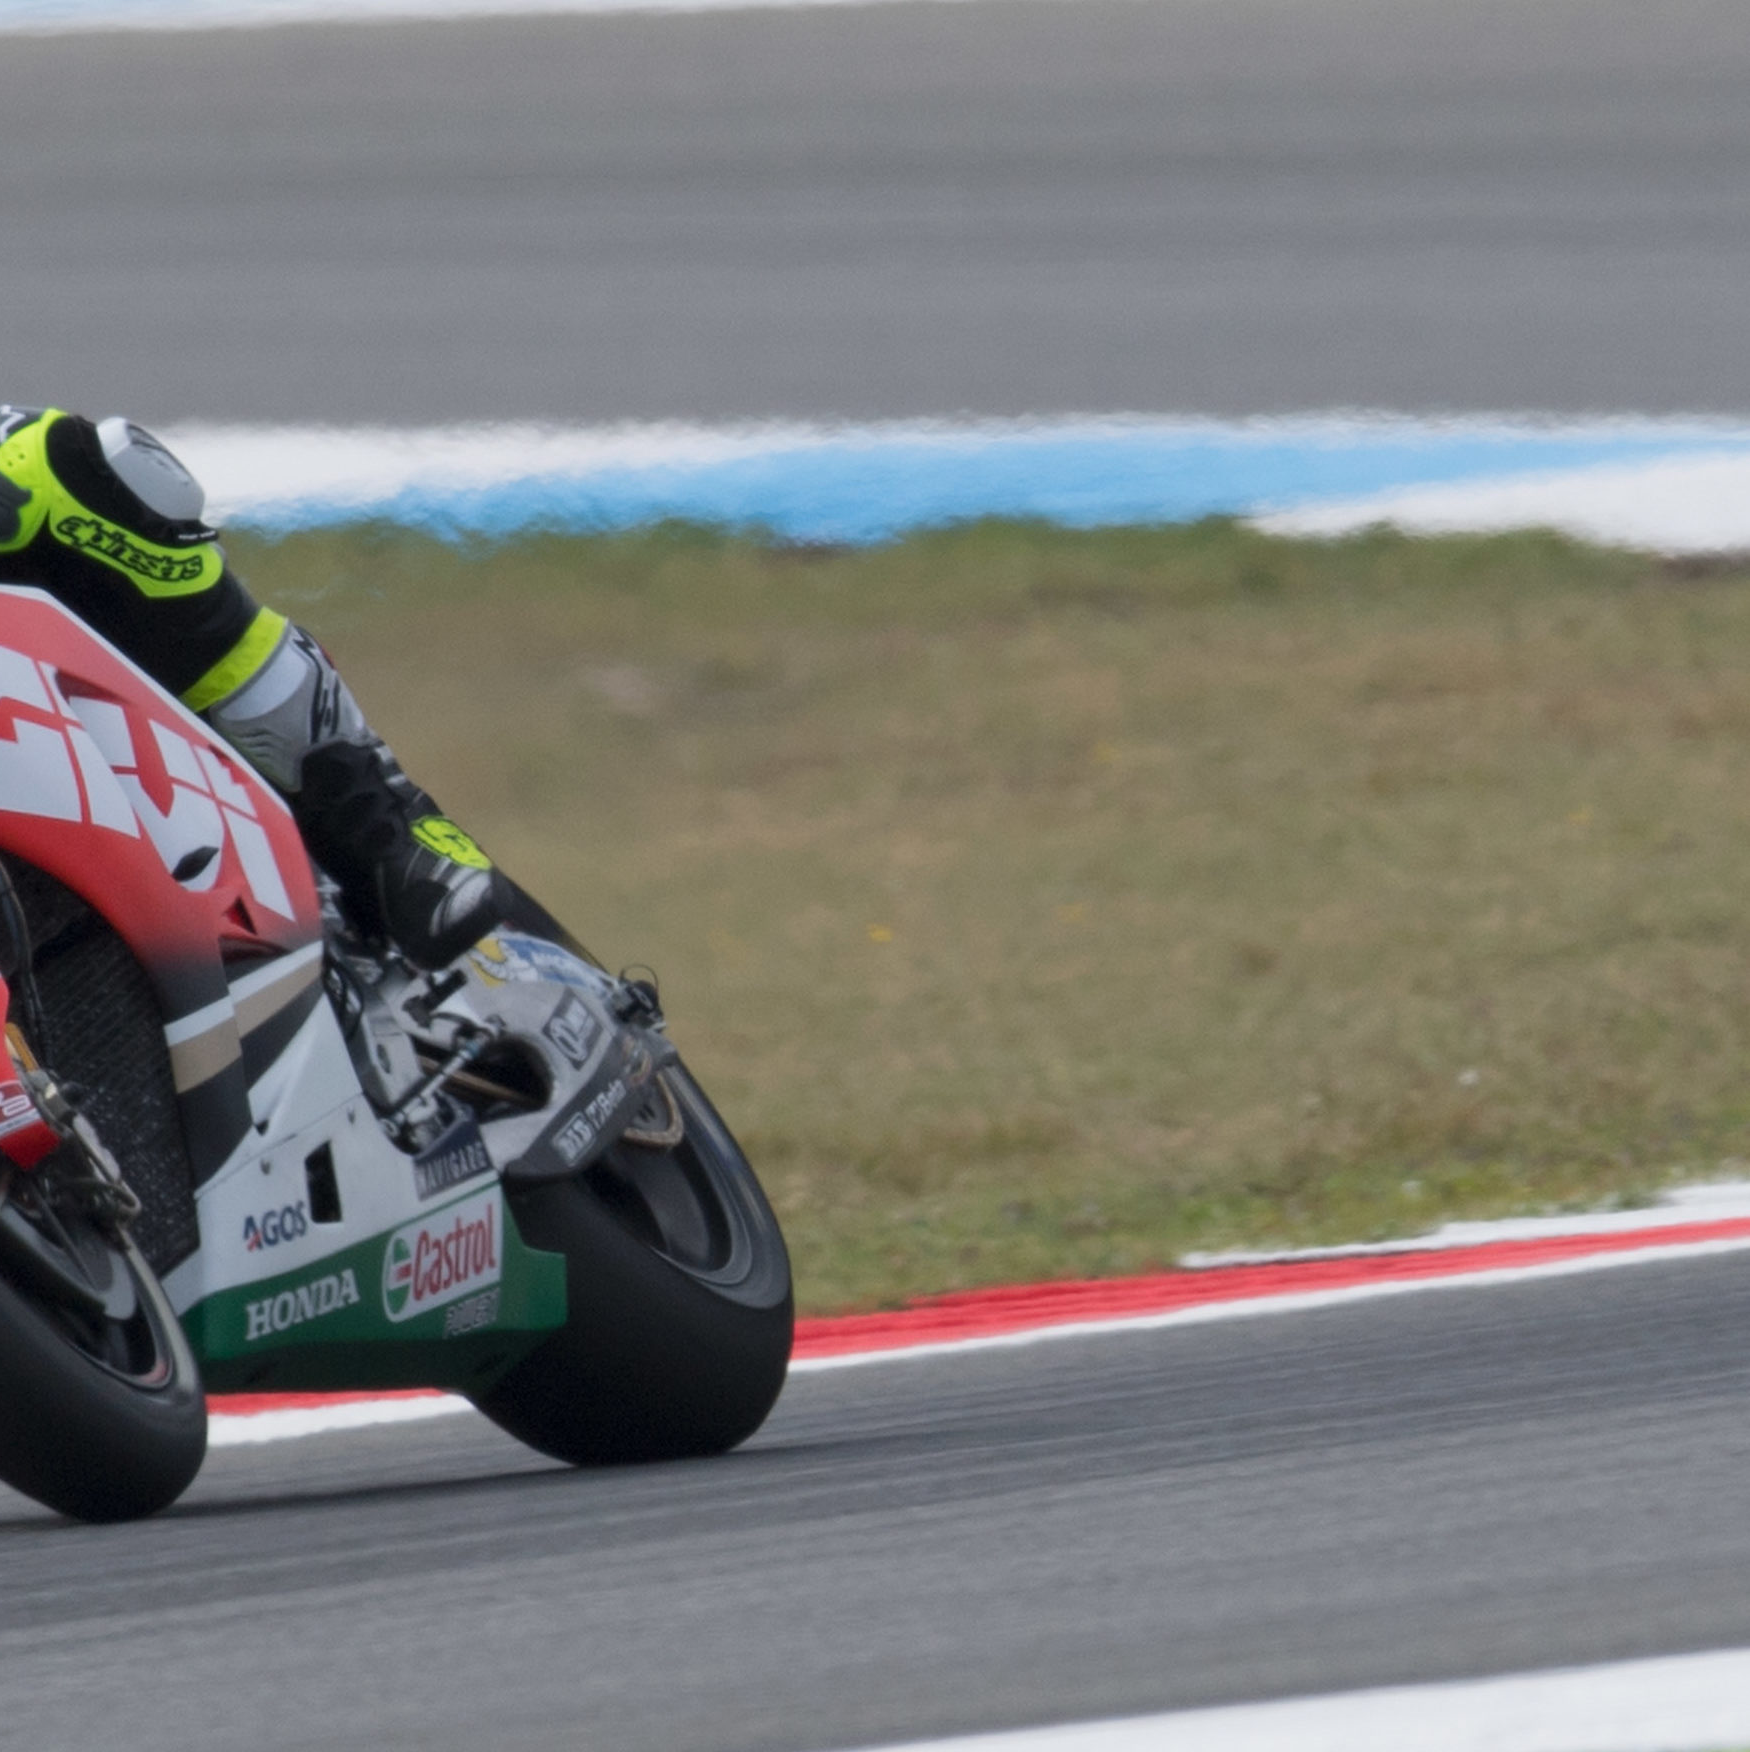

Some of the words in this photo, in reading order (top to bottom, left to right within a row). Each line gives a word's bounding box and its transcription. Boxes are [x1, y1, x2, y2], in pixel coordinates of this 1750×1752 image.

[243, 1200, 308, 1252] AGOS
[413, 1201, 496, 1301] Castrol
[245, 1268, 361, 1341] HONDA
